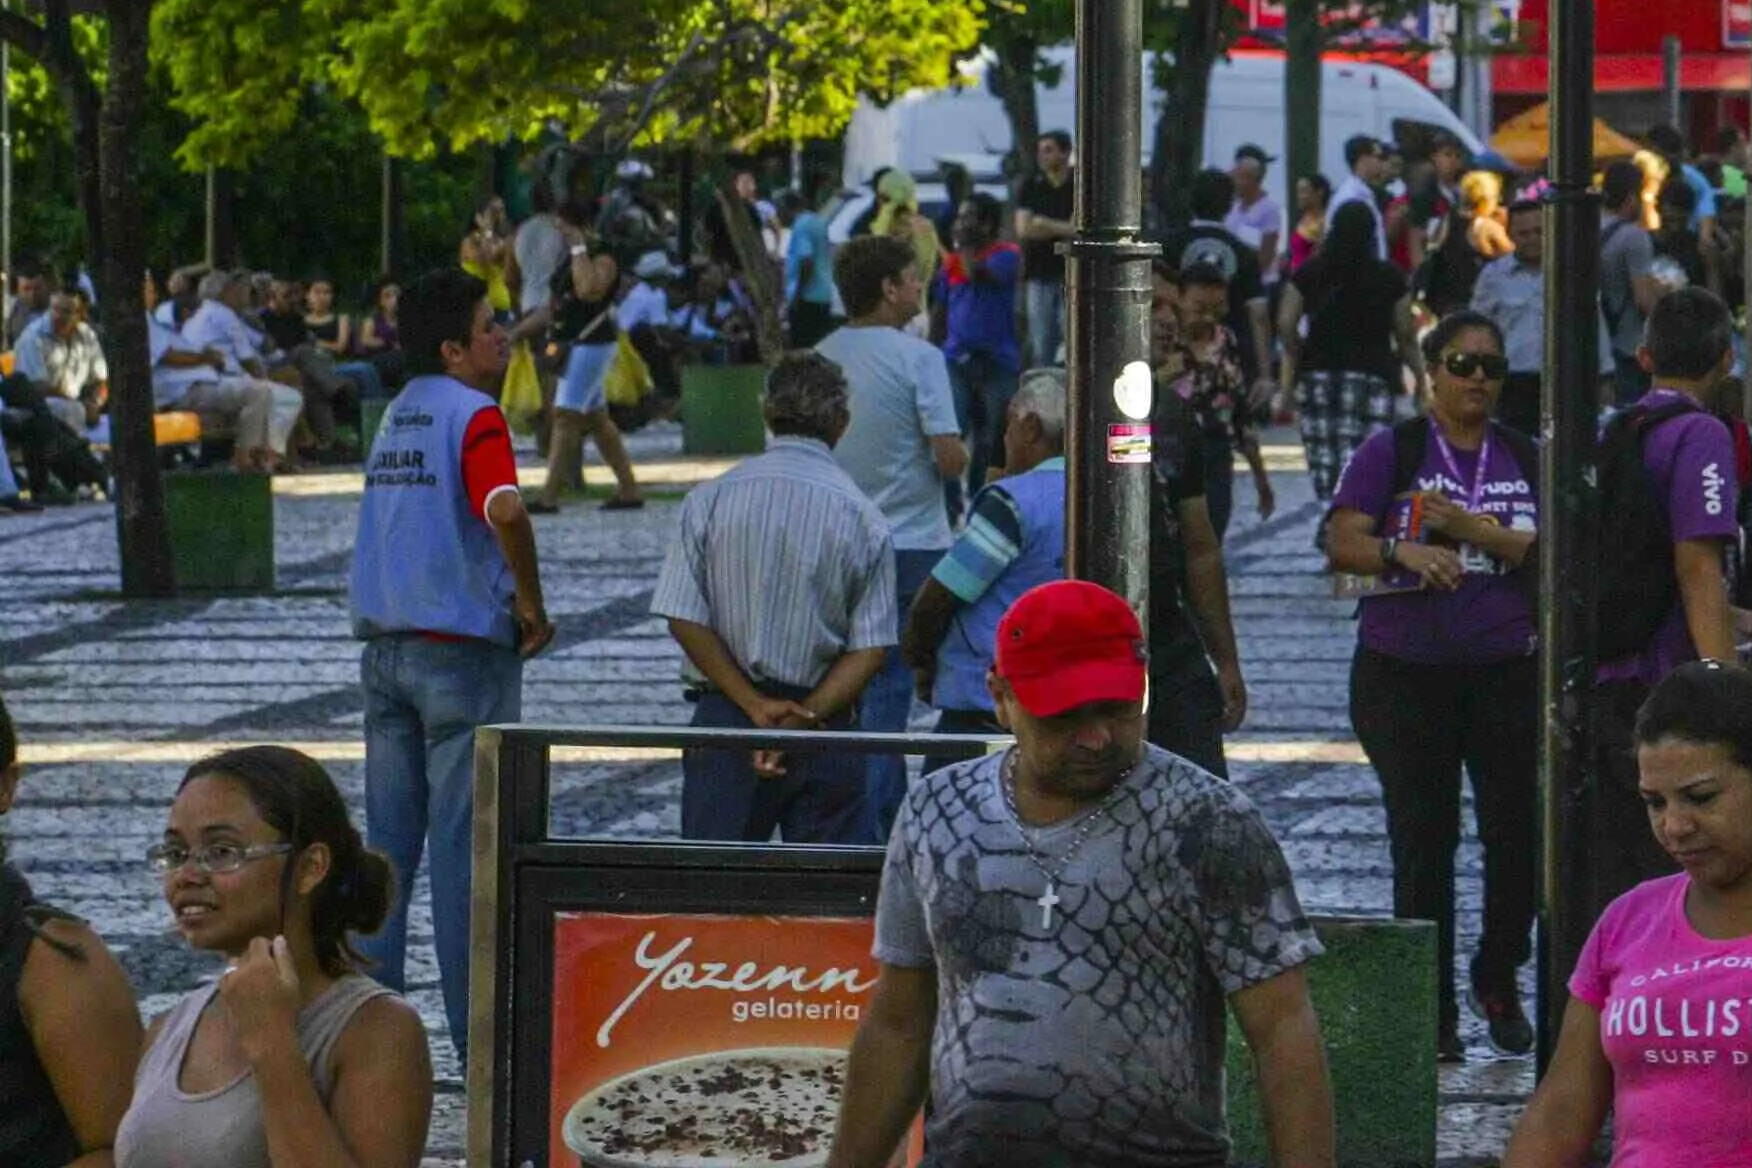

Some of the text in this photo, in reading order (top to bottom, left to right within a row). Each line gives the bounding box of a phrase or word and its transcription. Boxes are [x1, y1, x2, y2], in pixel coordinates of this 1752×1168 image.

[1702, 463, 1725, 515] vivo
[732, 997, 860, 1022] gelateria
[1644, 1049, 1717, 1065] SURF
